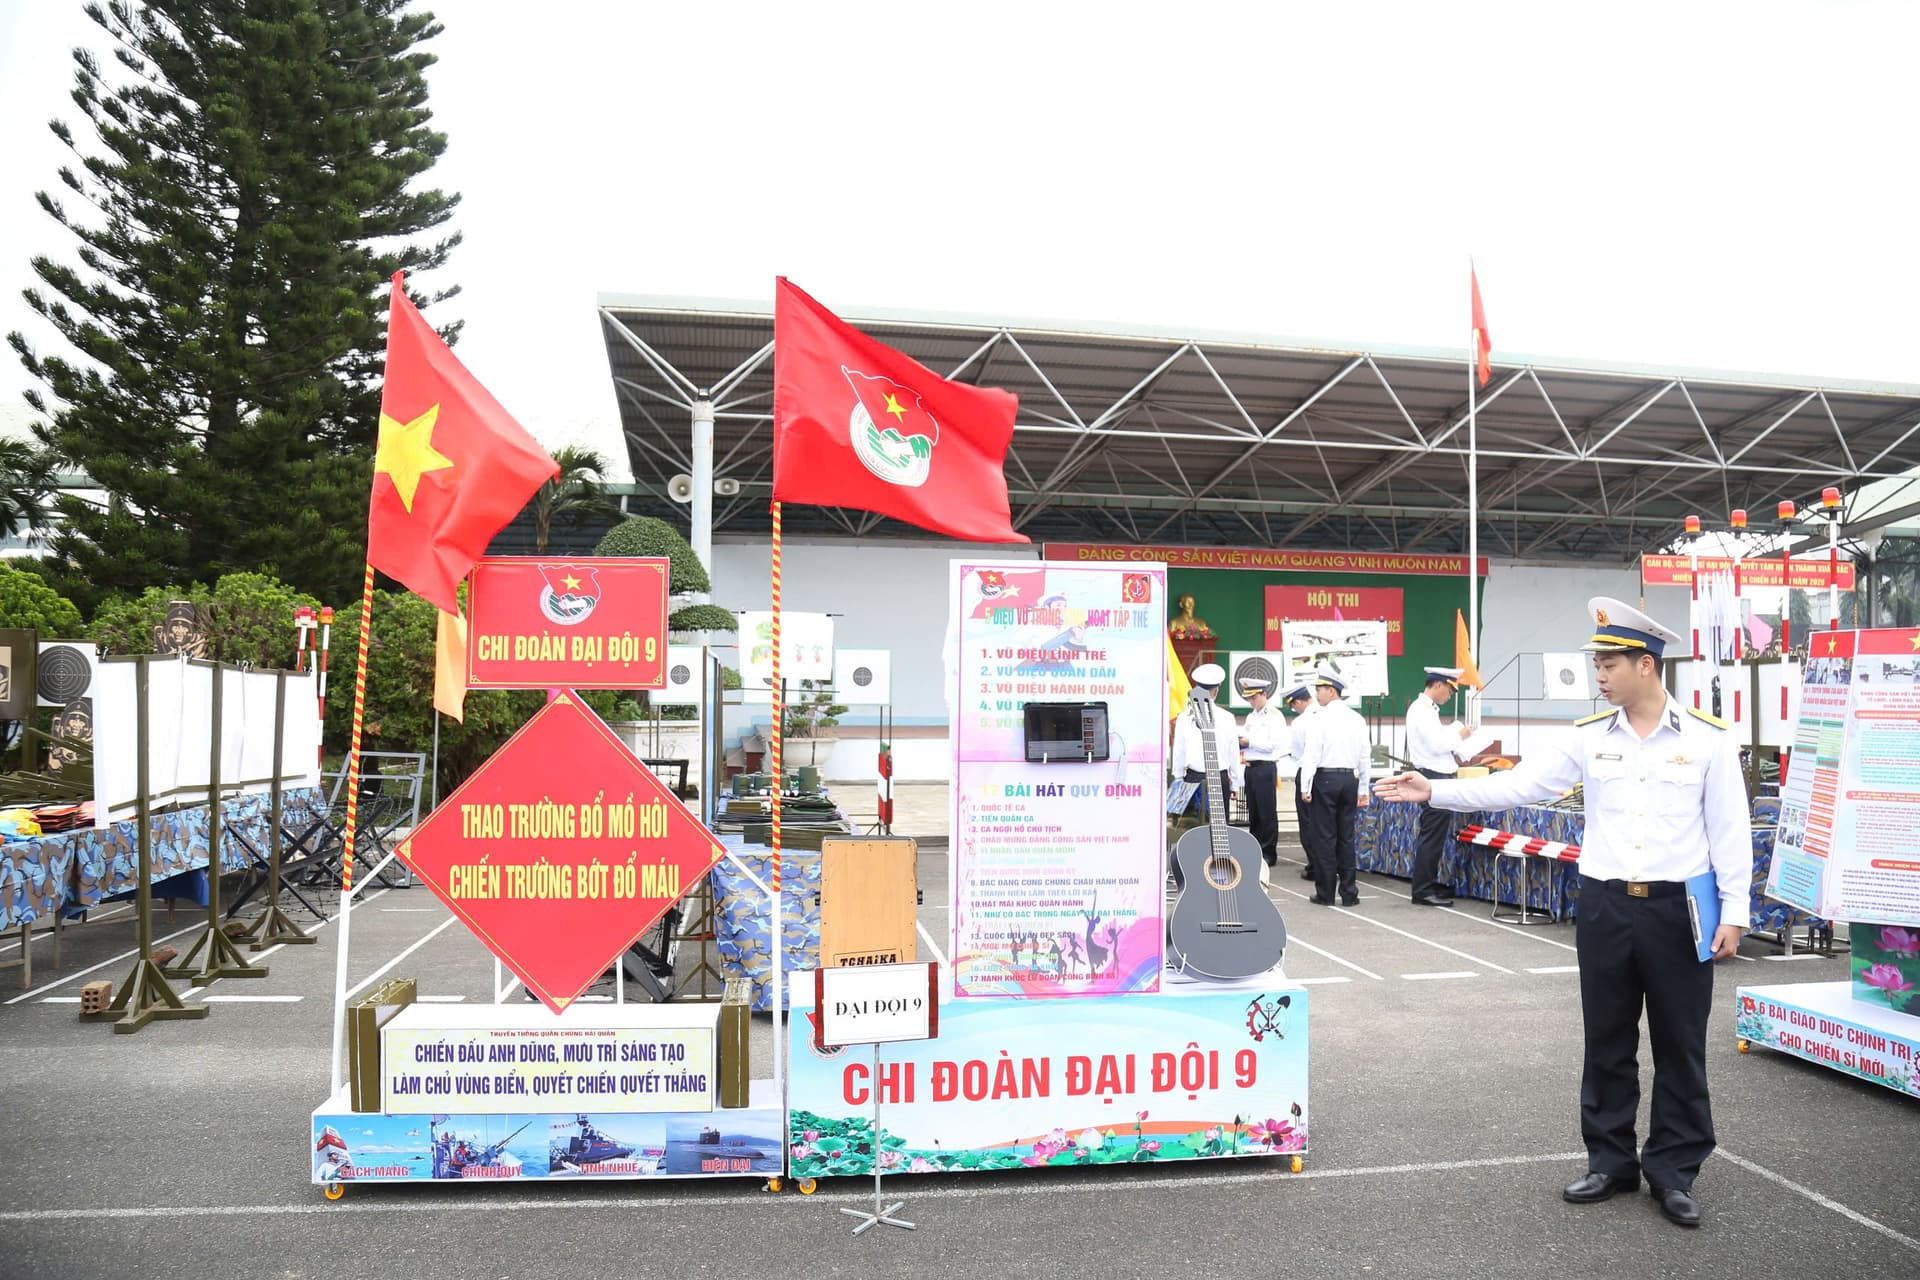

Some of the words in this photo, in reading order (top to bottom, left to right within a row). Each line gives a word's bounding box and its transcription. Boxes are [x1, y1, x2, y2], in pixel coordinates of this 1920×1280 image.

[1182, 548, 1212, 563] SẢN
[1251, 553, 1287, 566] NAM
[1290, 555, 1345, 567] QUANG
[1348, 556, 1380, 569] VINH
[1307, 590, 1332, 609] HỘI
[1336, 593, 1359, 607] THI
[478, 635, 509, 661] CHI
[514, 631, 565, 661] ĐOÀN
[571, 637, 602, 667] ĐẠI
[608, 632, 639, 667] ĐỘI
[645, 637, 656, 662] 9
[981, 648, 992, 659] 1.
[980, 666, 992, 676] 2.
[980, 683, 992, 693] 3.
[980, 700, 992, 711] 4.
[1070, 784, 1099, 798] QUY
[461, 804, 504, 839] THAO
[508, 796, 576, 839] TRƯỜNG
[580, 790, 605, 839] ĐỔ
[608, 792, 635, 839] MỒ
[640, 797, 668, 839] HÔI
[449, 853, 500, 899] CHIẾN
[505, 856, 573, 899] TRƯỜNG
[577, 856, 608, 899] BỚT
[613, 850, 636, 899] ĐỔ
[641, 857, 679, 899] MÁU
[913, 997, 922, 1010] 9
[1759, 1002, 1766, 1015] 6
[1790, 1010, 1816, 1031] GIÁO
[1820, 1019, 1844, 1040] DỤC
[1847, 1029, 1886, 1053] CHÍNH
[1890, 1040, 1911, 1065] TRỊ
[415, 1038, 454, 1062] CHIẾN
[458, 1038, 484, 1062] ĐẤU
[488, 1044, 516, 1062] ANH
[519, 1041, 559, 1064] DŨNG,
[564, 1042, 593, 1062] MƯU
[597, 1040, 617, 1061] TRÍ
[621, 1040, 656, 1061] SÁNG
[660, 1043, 685, 1065] TẠO
[1779, 1031, 1801, 1050] CHO
[1805, 1041, 1840, 1063] CHIẾN
[393, 1072, 421, 1094] LÀM
[425, 1070, 451, 1094] CHỦ
[455, 1072, 490, 1094] VÙNG
[494, 1069, 528, 1096] BIỂN,
[533, 1070, 573, 1095] QUYẾT
[577, 1070, 616, 1094] CHIẾN
[620, 1069, 660, 1095] QUYẾT
[664, 1068, 706, 1093] THẮNG
[843, 1062, 915, 1106] CHI
[931, 1050, 1050, 1102] ĐOÀN
[1065, 1053, 1136, 1104] ĐẠI
[1151, 1042, 1219, 1100] ĐỘI
[1234, 1048, 1257, 1089] 9
[500, 1166, 521, 1177] QUY
